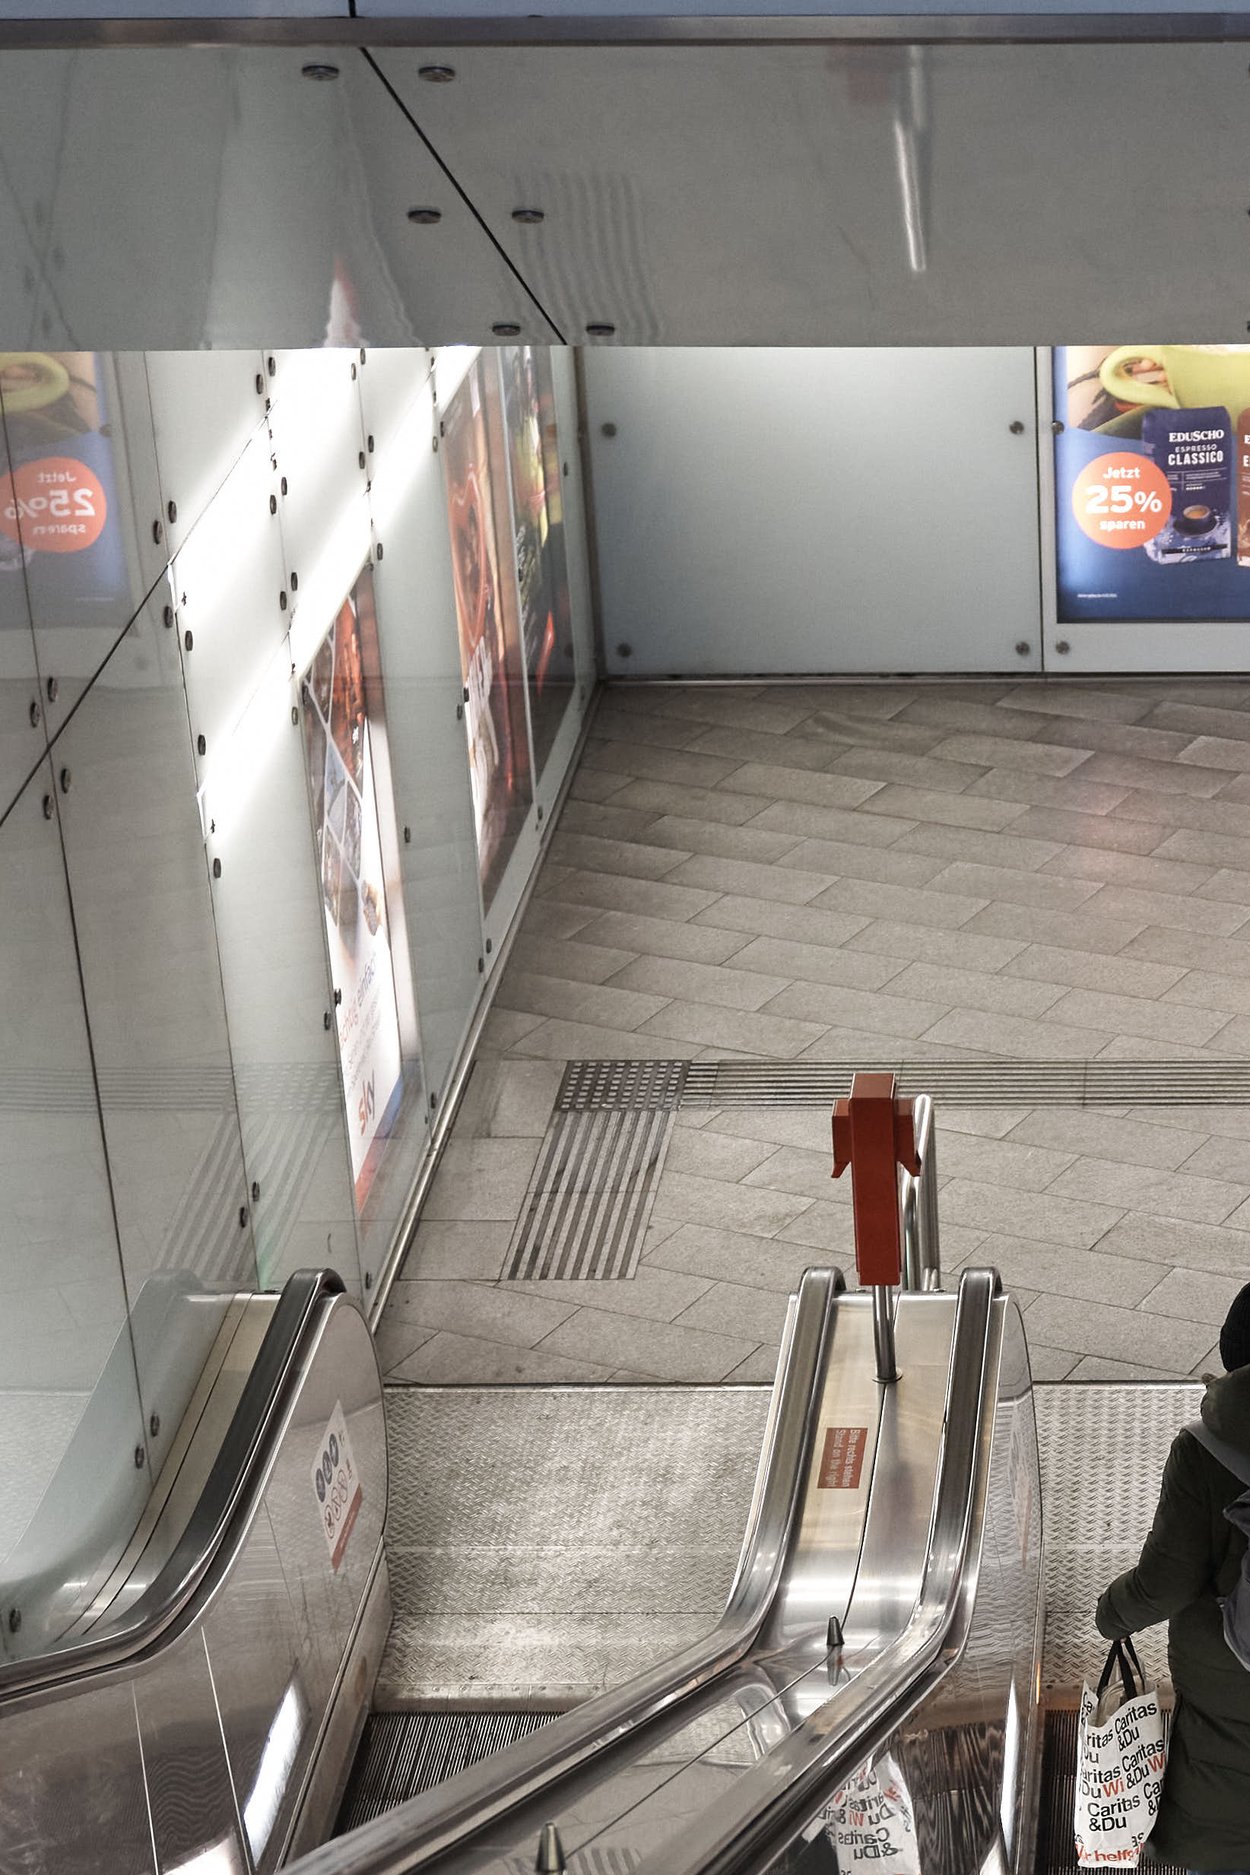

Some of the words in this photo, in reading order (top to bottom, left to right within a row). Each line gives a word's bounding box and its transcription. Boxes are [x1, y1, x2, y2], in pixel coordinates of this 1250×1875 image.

[1169, 429, 1224, 442] EDUSCHO
[1168, 451, 1223, 465] CLASSICO
[1175, 444, 1217, 453] ESPRESSO
[1103, 467, 1140, 479] Jetzt
[1086, 484, 1162, 515] 25%
[1099, 520, 1146, 532] sparen
[1114, 1702, 1157, 1735] Caritas
[1117, 1726, 1139, 1751] &Du
[1121, 1739, 1165, 1772] Caritas
[1102, 1776, 1125, 1798] Wi
[1126, 1764, 1150, 1789] &Du
[1087, 1794, 1141, 1817] Caritas
[1088, 1816, 1127, 1833] &Du
